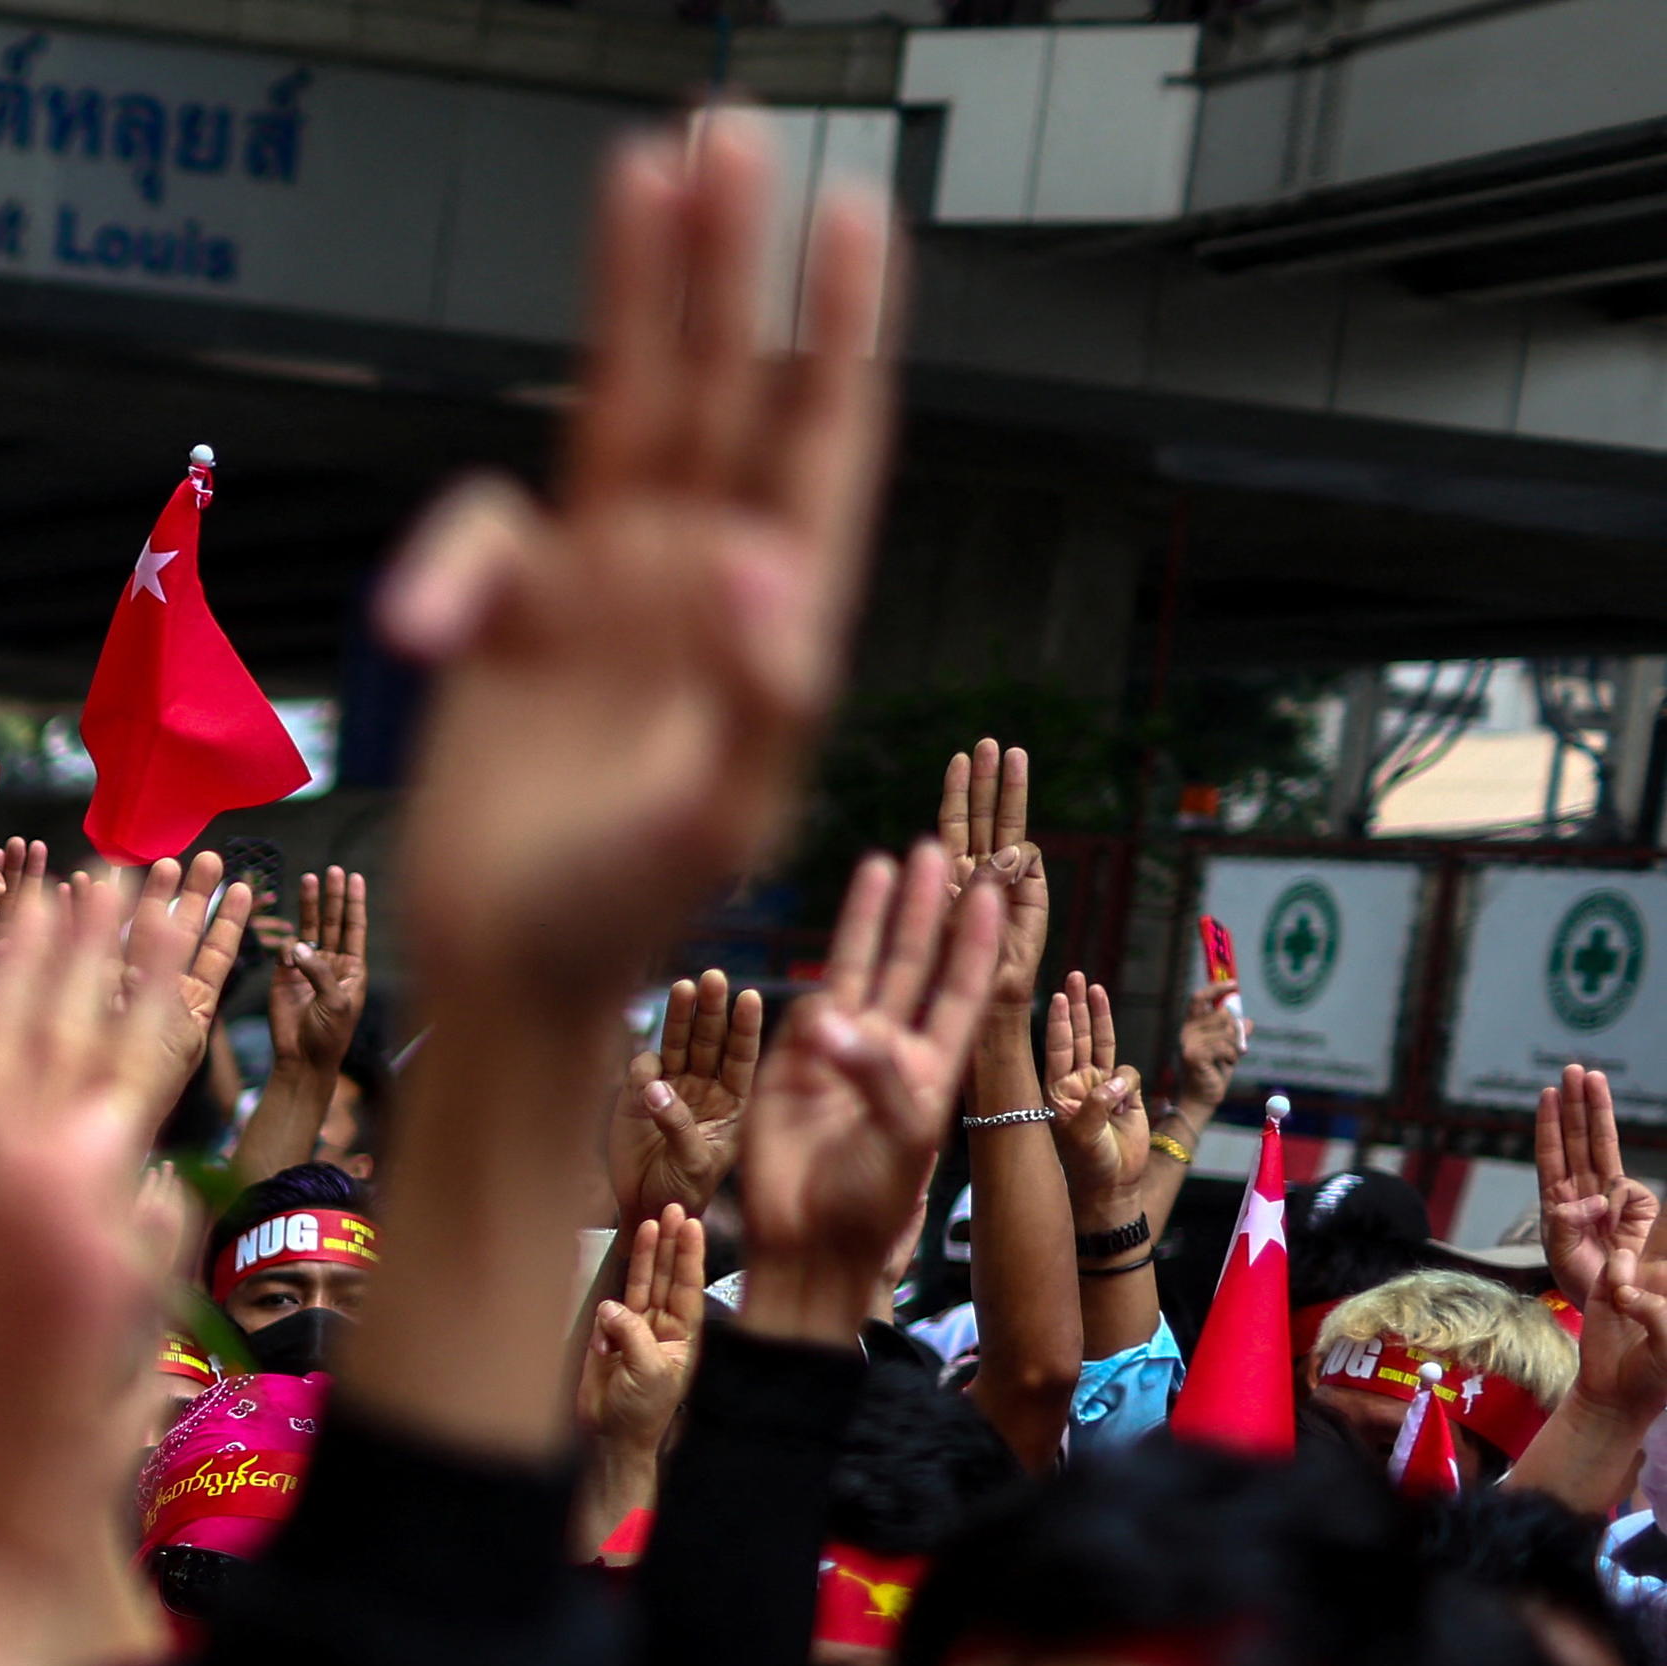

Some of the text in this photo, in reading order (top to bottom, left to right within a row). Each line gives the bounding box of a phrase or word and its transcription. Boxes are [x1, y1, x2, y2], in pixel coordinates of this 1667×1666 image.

[53, 205, 240, 284] Louis
[235, 1212, 319, 1273] NUG
[1320, 1337, 1383, 1380] UG
